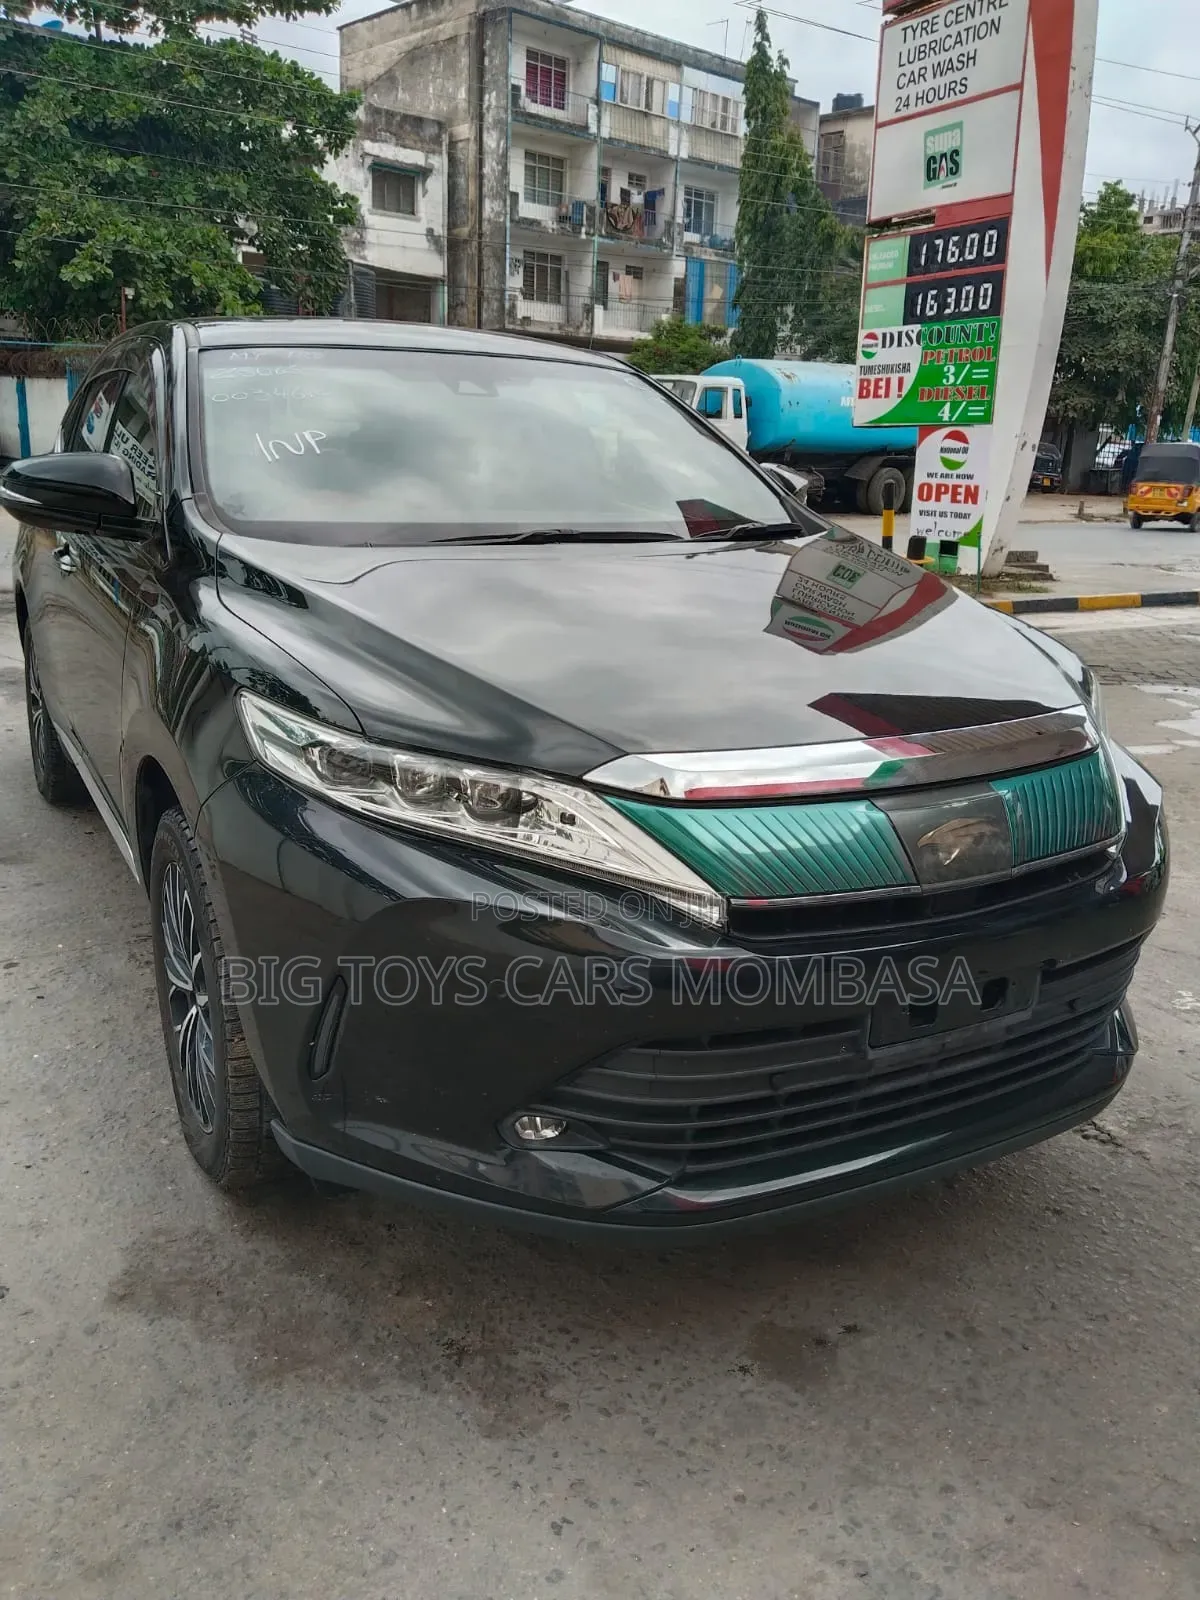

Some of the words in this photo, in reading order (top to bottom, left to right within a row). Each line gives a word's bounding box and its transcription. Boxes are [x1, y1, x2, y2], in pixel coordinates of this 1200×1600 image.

[901, 15, 939, 44] TYRE
[943, 0, 1008, 28] CENTRE
[898, 16, 1001, 68] LUBRICATION
[896, 66, 928, 90] CAR
[931, 48, 977, 79] WASH
[895, 94, 910, 113] 24
[915, 76, 968, 108] HOURS
[926, 149, 960, 182] GAS
[921, 229, 998, 266] 176.00
[916, 282, 993, 316] 163.00
[880, 321, 998, 349] DISCOUNT!
[921, 345, 997, 365] PETROL
[857, 376, 892, 400] BEI
[917, 384, 991, 402] DIESEL
[917, 482, 979, 505] OPEN
[919, 509, 937, 517] VISIT
[949, 511, 971, 520] TODAY
